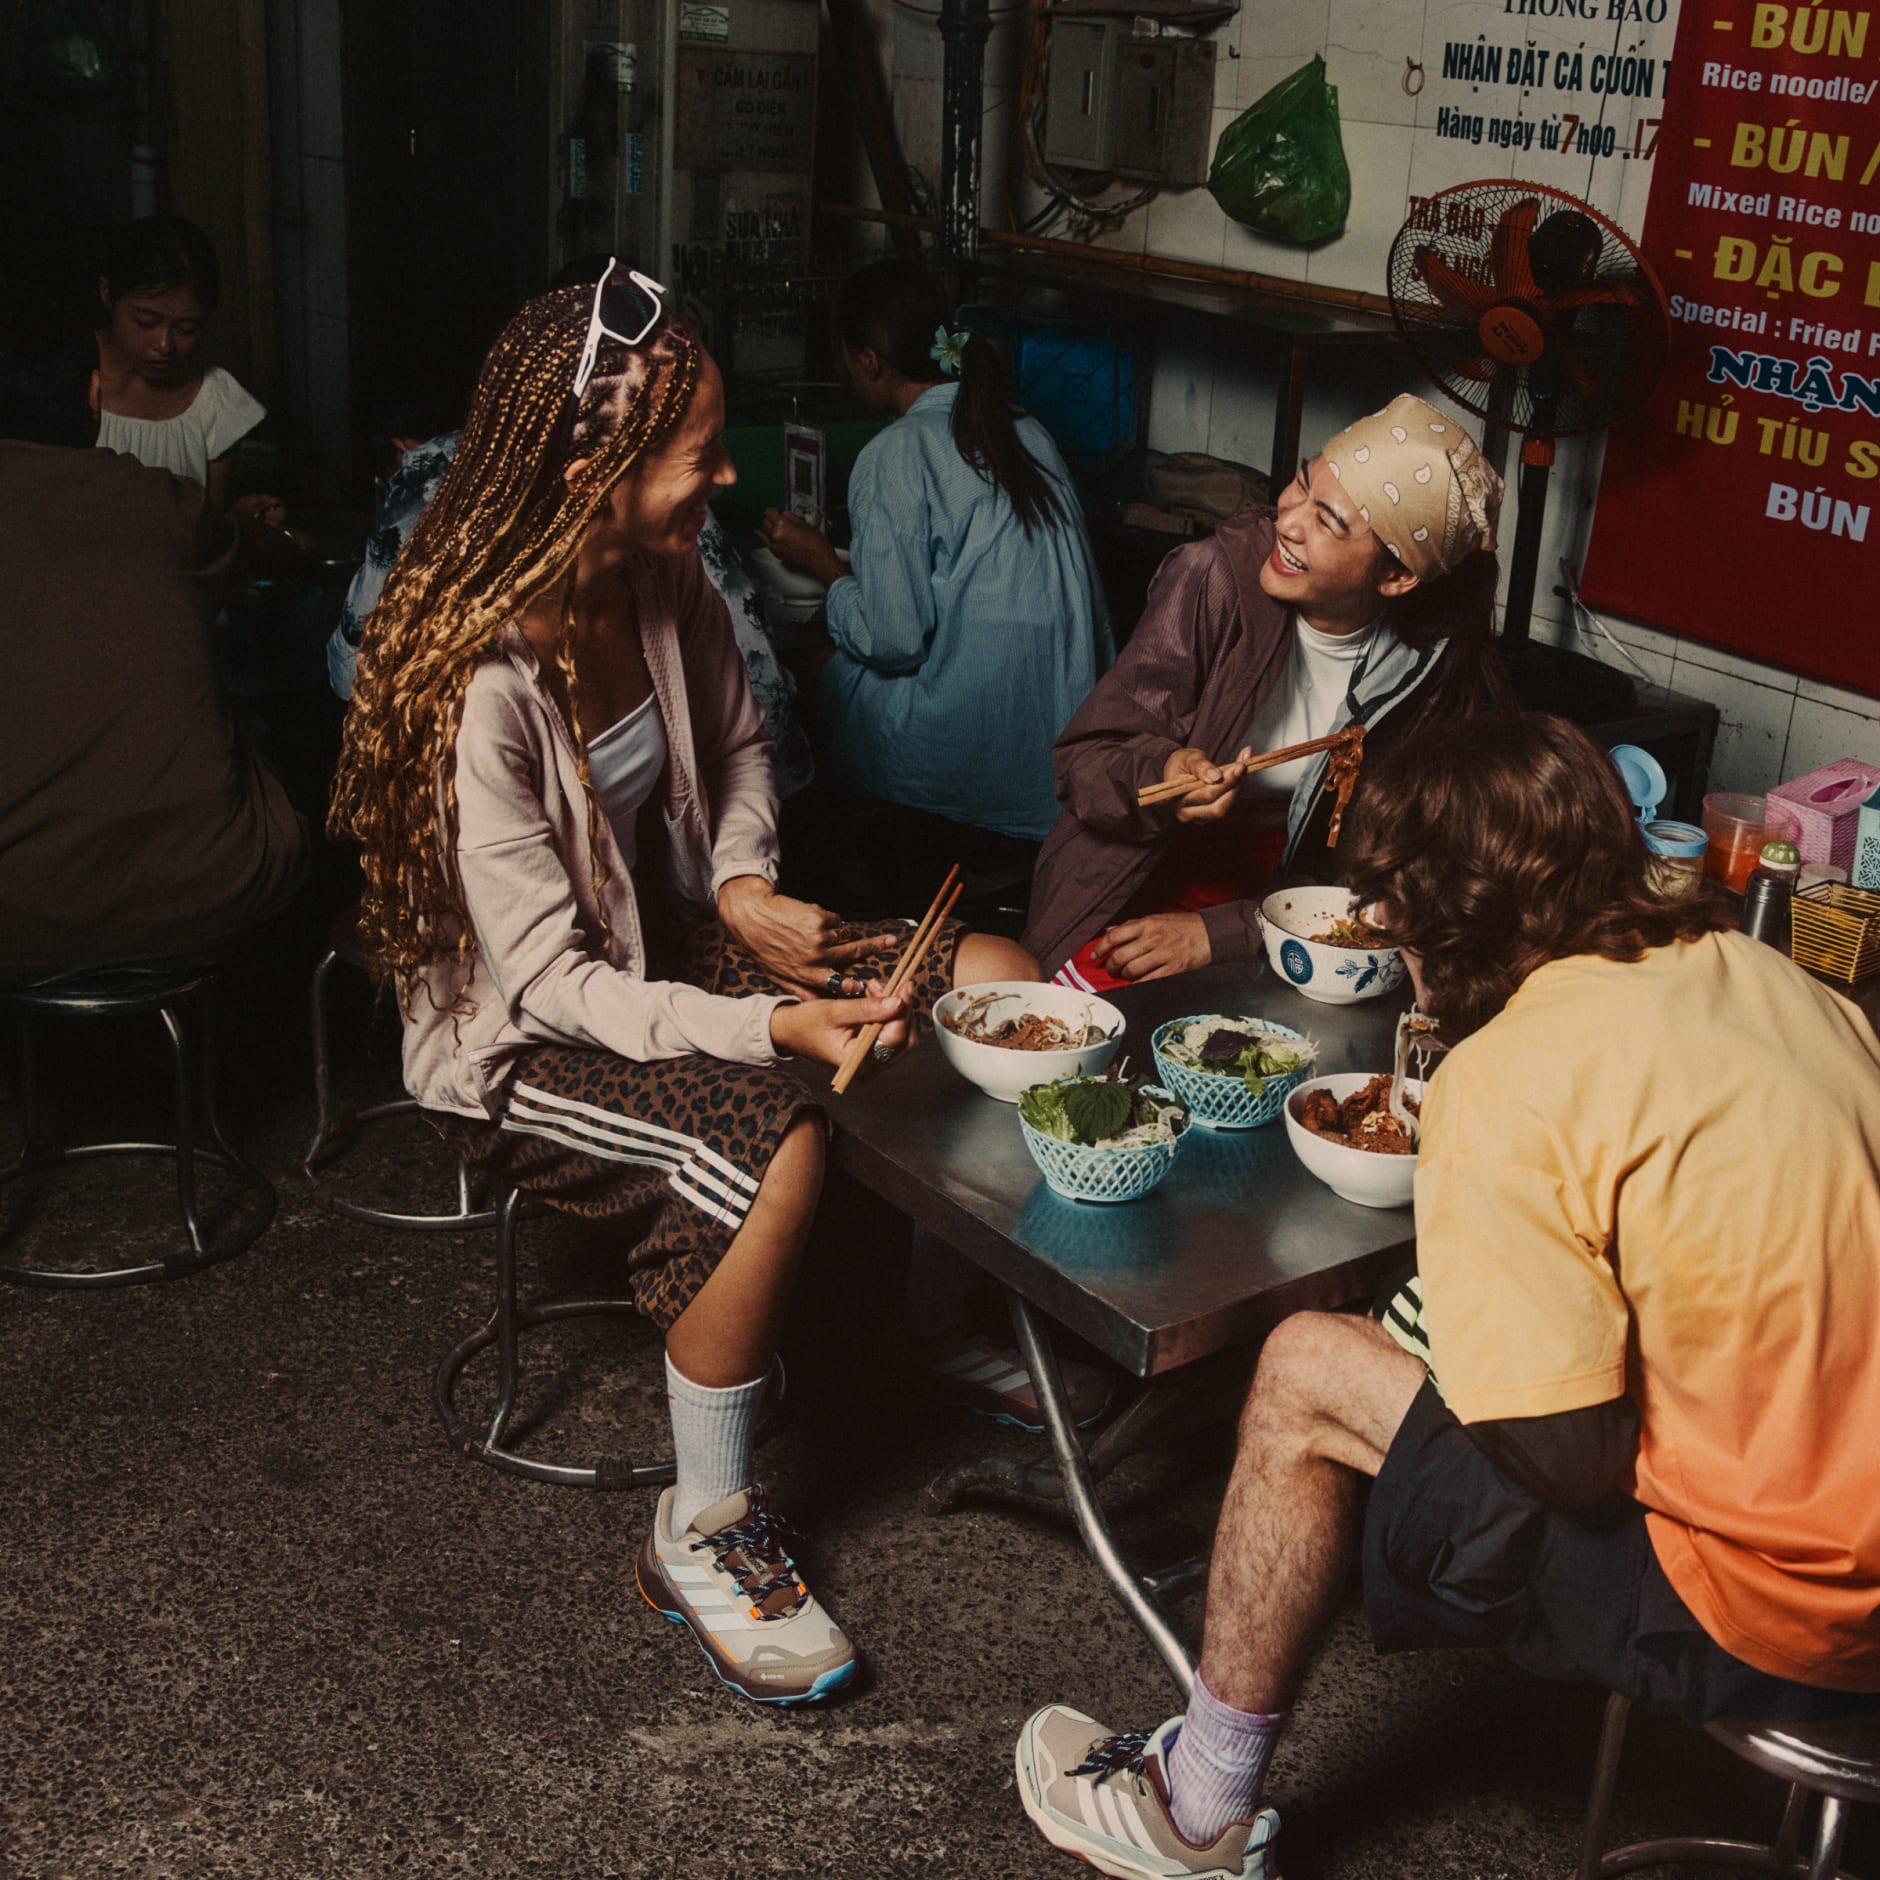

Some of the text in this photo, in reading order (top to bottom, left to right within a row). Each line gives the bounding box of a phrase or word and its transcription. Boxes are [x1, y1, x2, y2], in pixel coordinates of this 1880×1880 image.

[1749, 0, 1871, 59] BÚN
[1442, 34, 1503, 94] NHẬN
[1506, 40, 1549, 97] ĐẶT
[1553, 41, 1585, 91] CÁ
[1590, 39, 1655, 98] CUỐN
[1701, 61, 1762, 92] Rice
[1436, 106, 1483, 146] Hàng
[1488, 111, 1535, 151] ngày
[1729, 119, 1851, 182] BÚN
[1687, 182, 1771, 218] Mixed
[1776, 195, 1842, 229] Rice
[1713, 233, 1844, 300] ĐẶC
[1669, 294, 1767, 336] Special
[1788, 317, 1862, 354] Fried
[1706, 345, 1880, 418] NHẬN
[1675, 393, 1739, 446] HỦ
[1757, 415, 1830, 468] TÍU
[1764, 482, 1871, 543] BÚN
